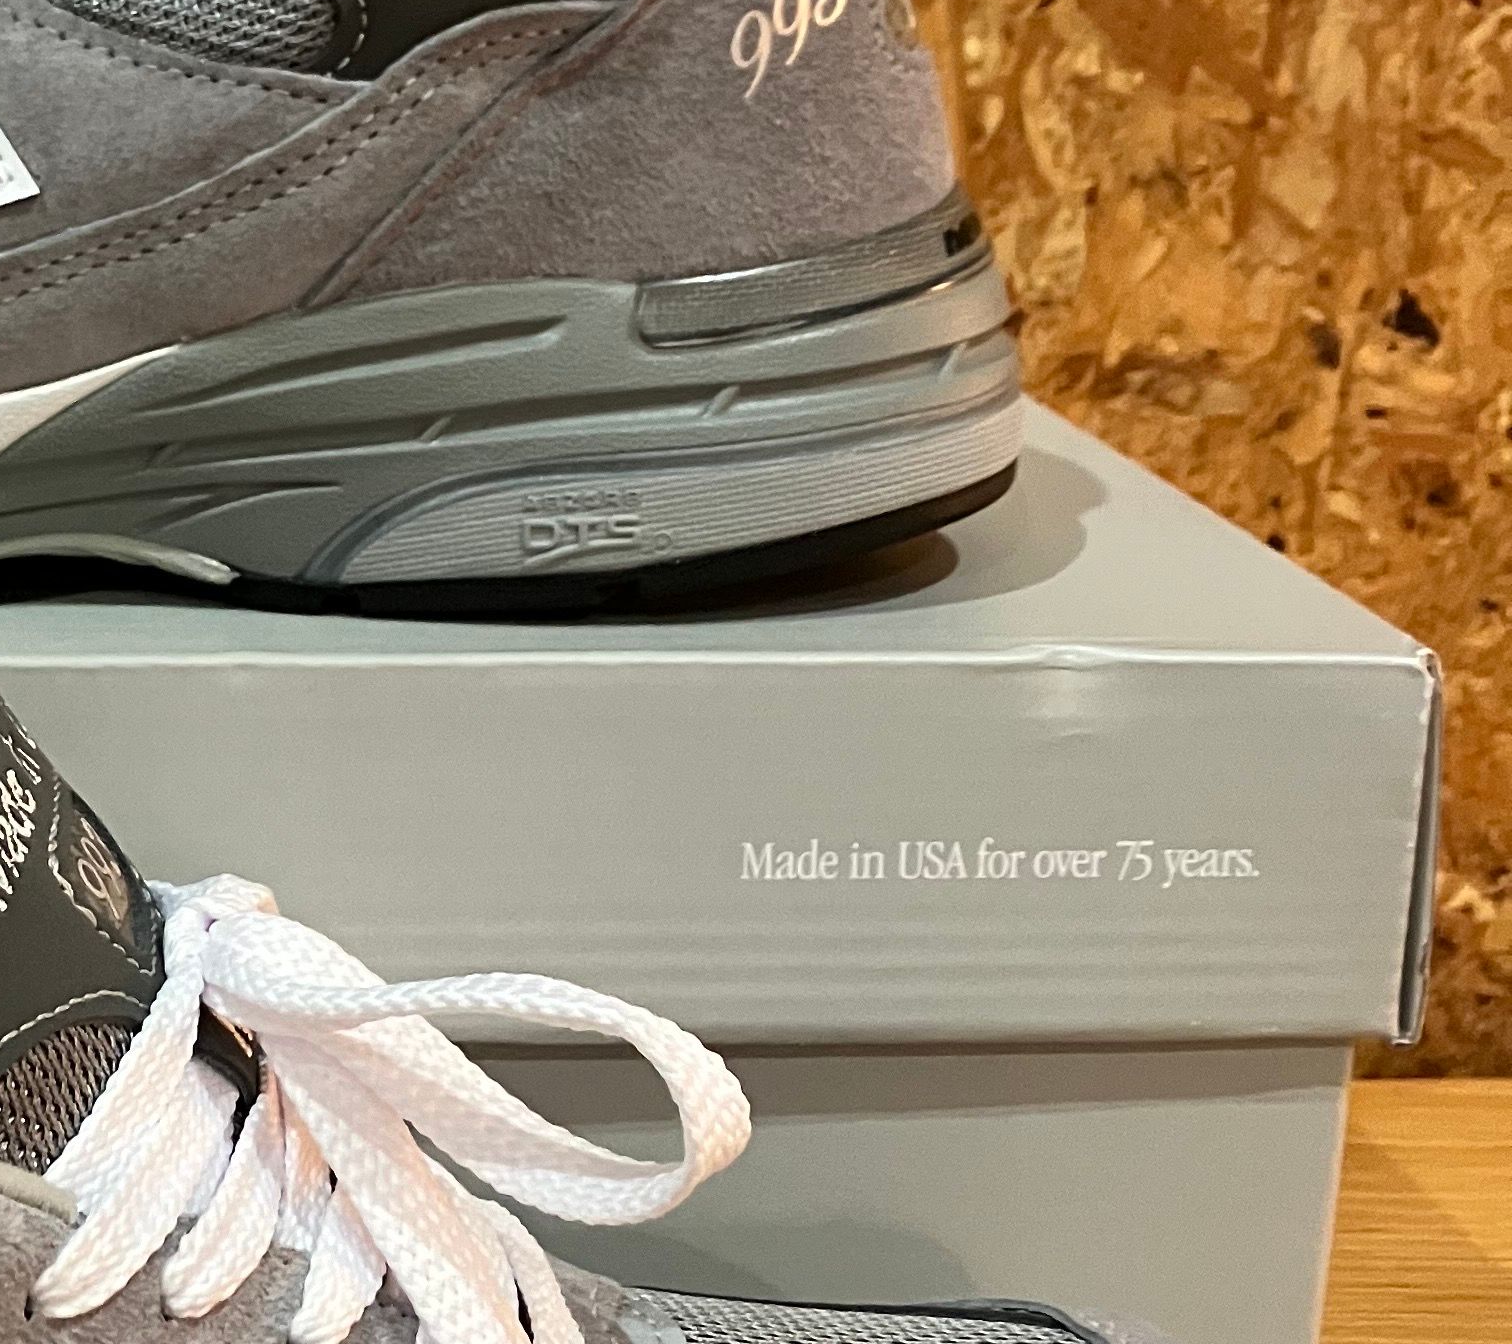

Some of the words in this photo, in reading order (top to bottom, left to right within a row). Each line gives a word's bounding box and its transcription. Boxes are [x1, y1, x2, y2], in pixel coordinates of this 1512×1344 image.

[520, 513, 640, 562] DTS
[740, 838, 839, 880] Made
[848, 841, 888, 880] in
[897, 840, 969, 880] USA
[974, 836, 1027, 879] for
[1032, 849, 1108, 879] over
[1115, 840, 1155, 881] 75
[1161, 847, 1260, 889] years.
